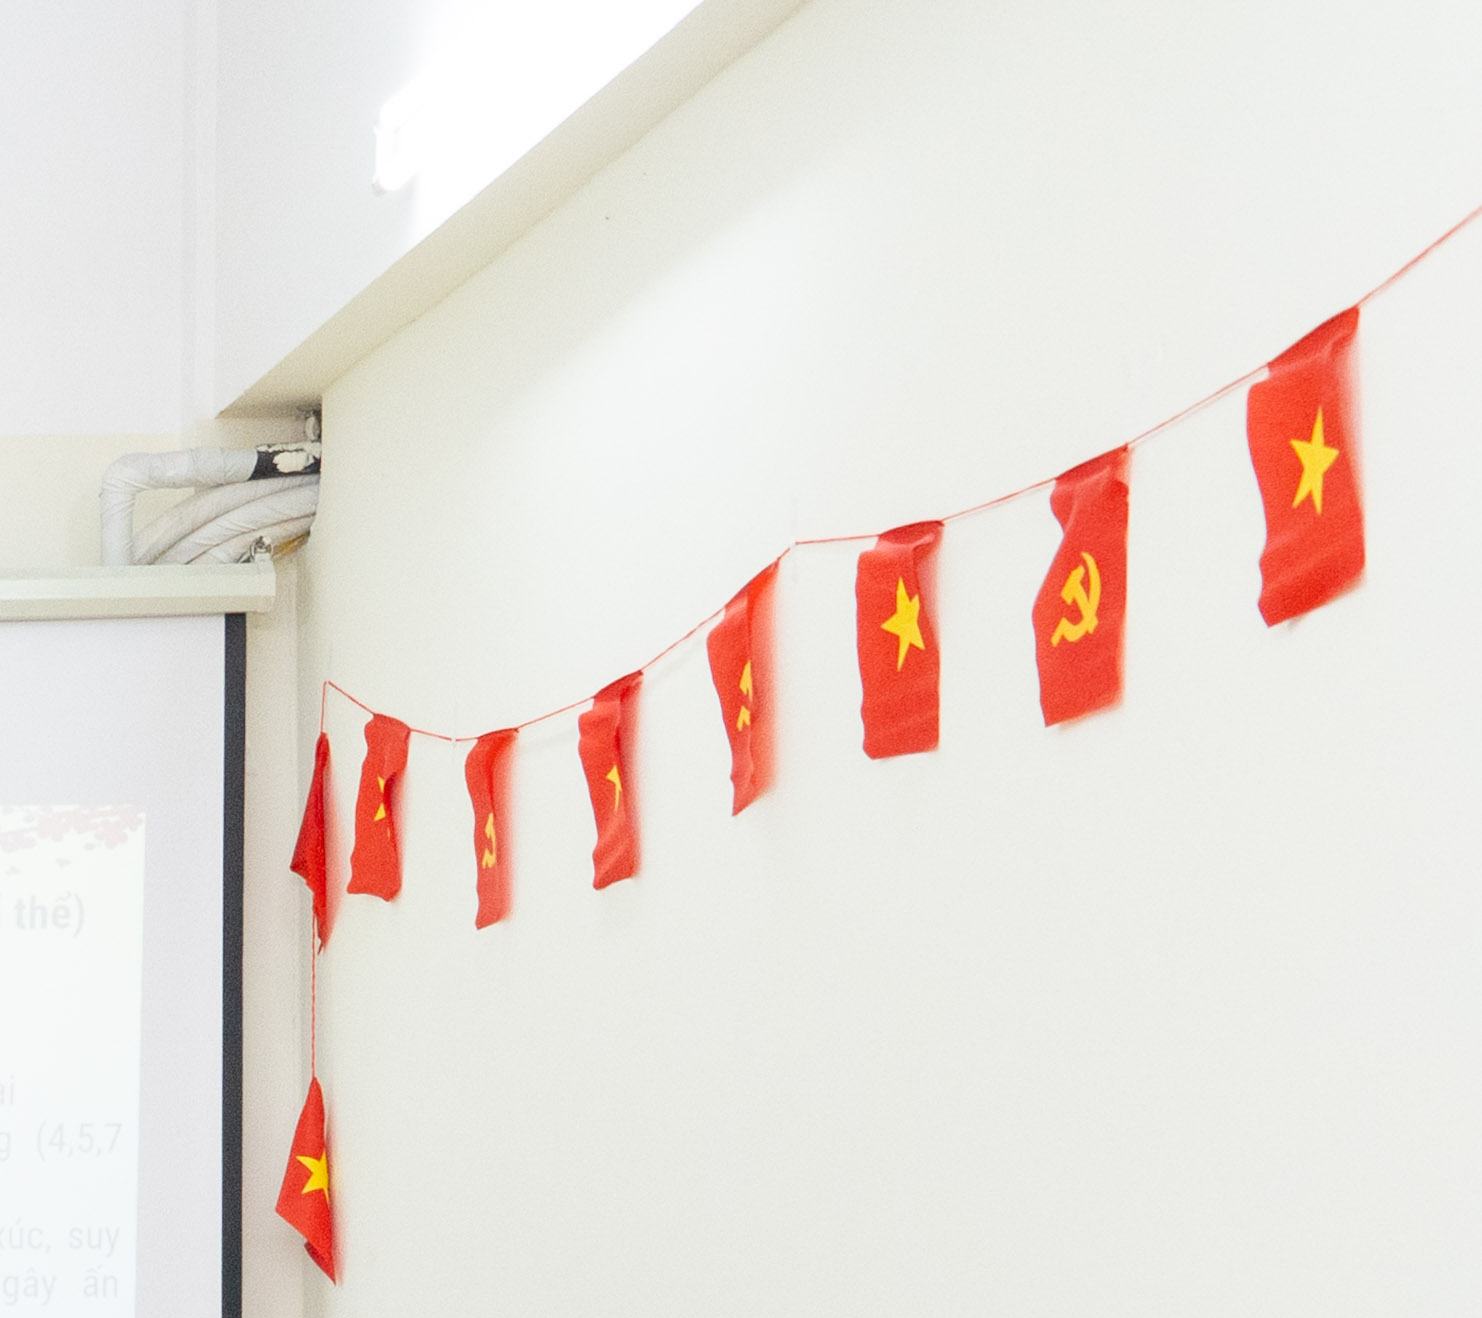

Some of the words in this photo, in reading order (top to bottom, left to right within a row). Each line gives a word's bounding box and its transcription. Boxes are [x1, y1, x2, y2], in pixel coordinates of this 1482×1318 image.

[13, 891, 85, 938] thể)
[37, 1121, 122, 1161] (4,5,7
[69, 1227, 120, 1258] suy
[2, 1267, 57, 1306] gây
[83, 1265, 118, 1298] ấn
